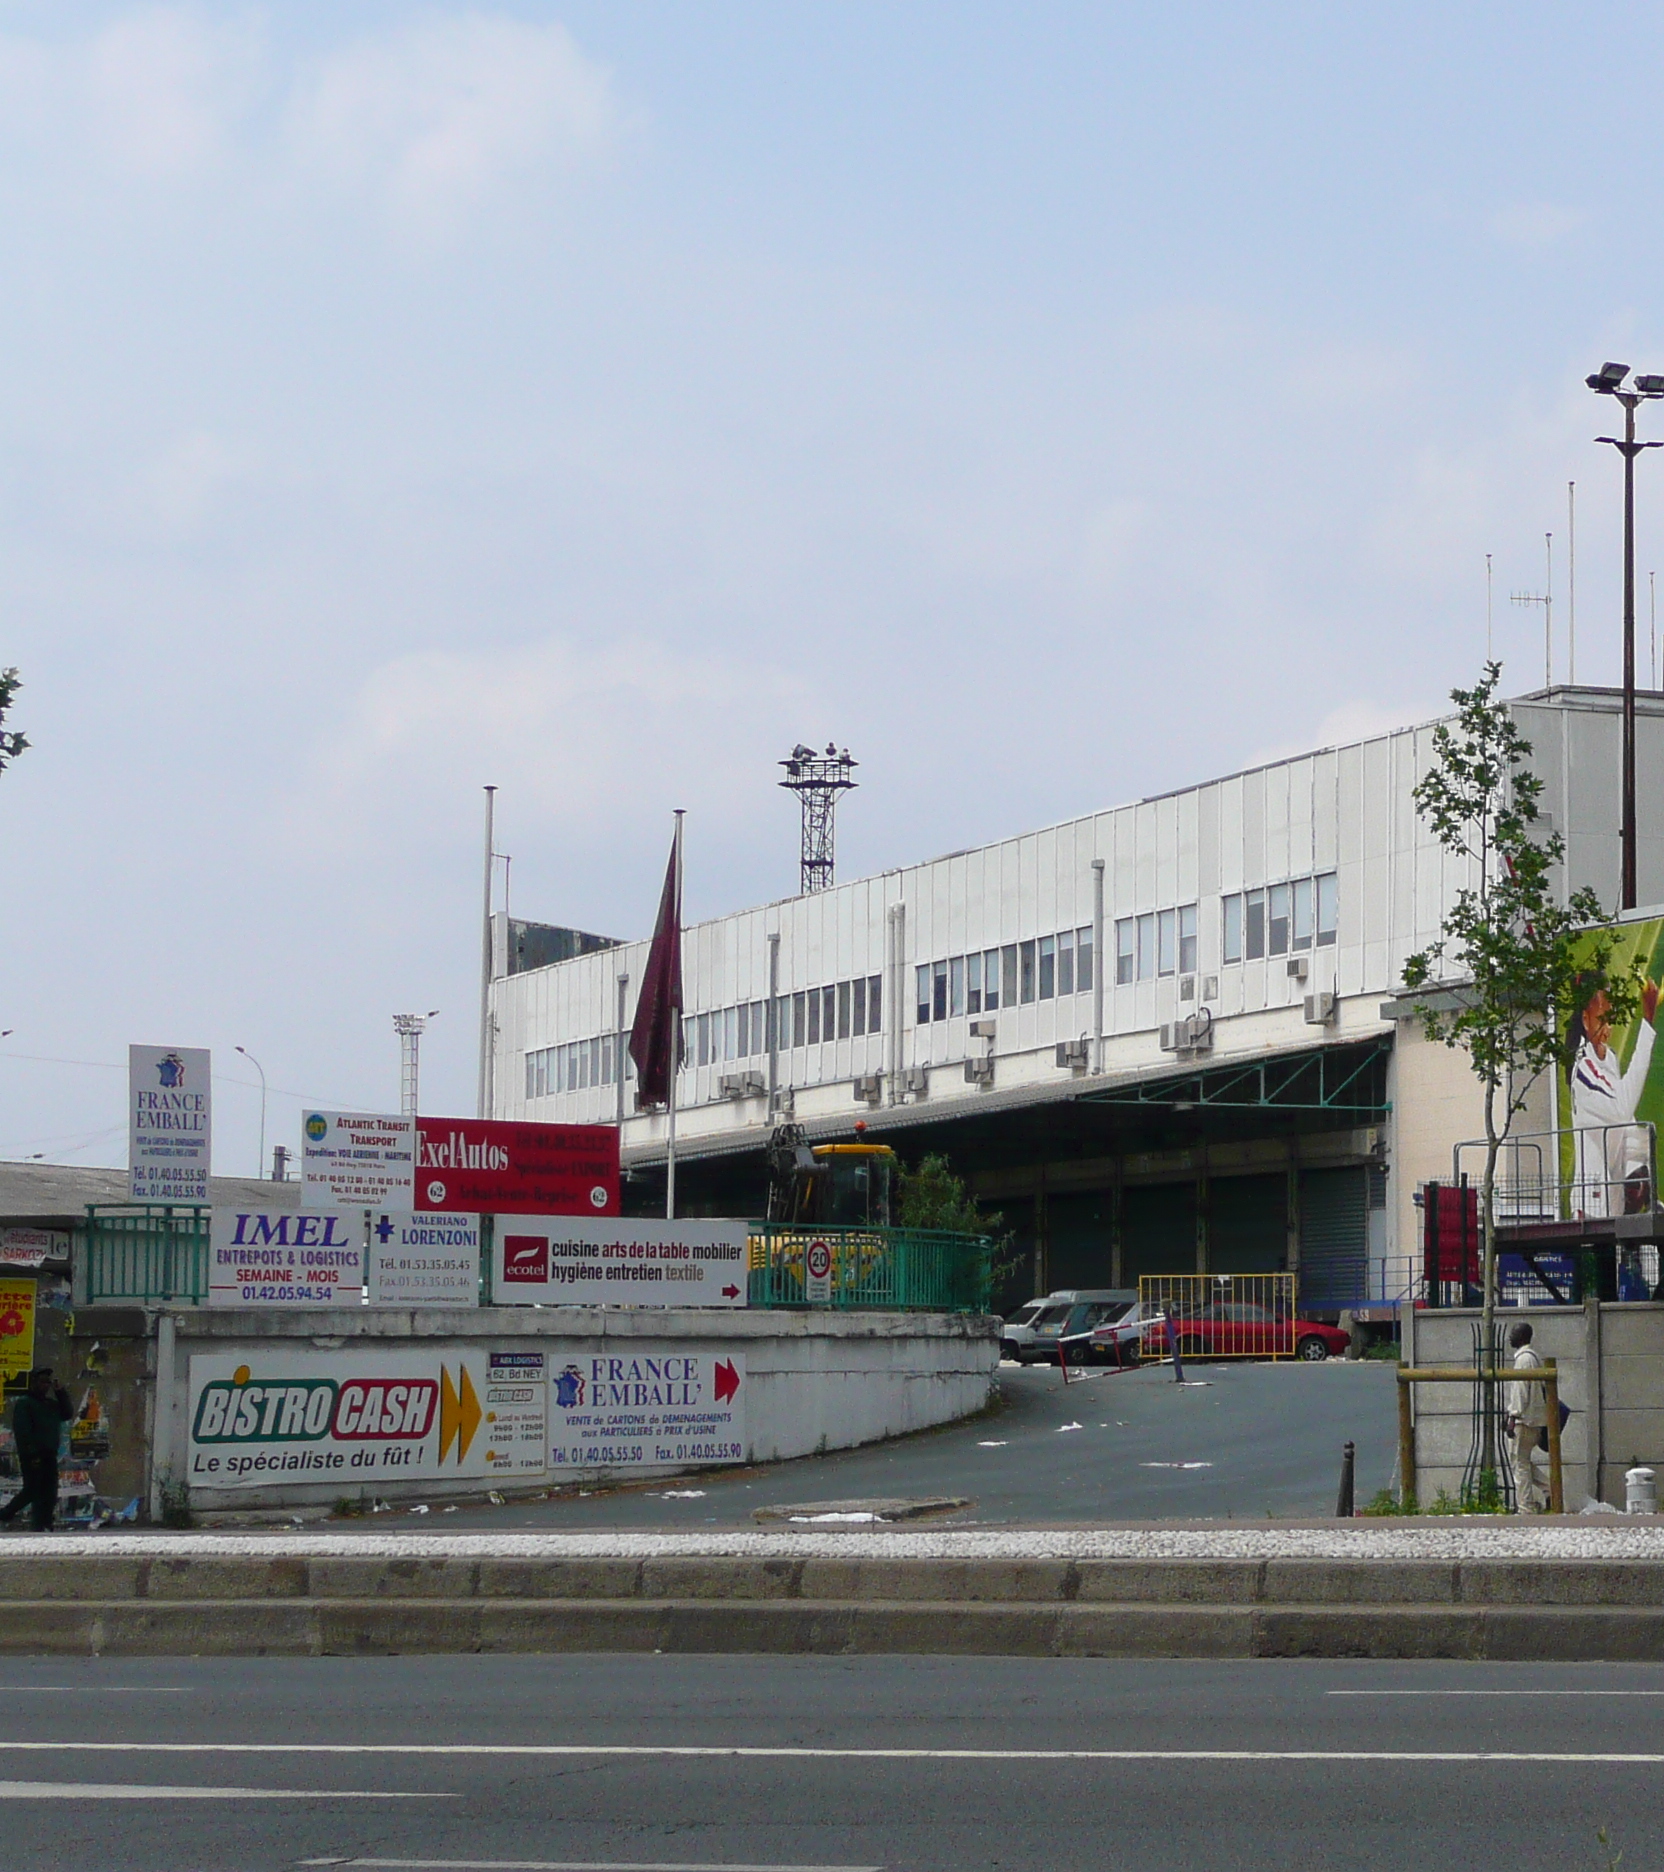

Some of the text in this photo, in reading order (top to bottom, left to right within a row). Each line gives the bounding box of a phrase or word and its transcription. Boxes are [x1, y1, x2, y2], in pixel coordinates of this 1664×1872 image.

[138, 1092, 204, 1112] FRANCE
[136, 1111, 206, 1130] EMBALL'
[350, 1134, 397, 1146] TRANSPORT
[416, 1130, 508, 1170] ExelAutos
[430, 1186, 444, 1198] 62
[592, 1190, 605, 1203] 62
[412, 1216, 468, 1226] VALERIANO
[230, 1214, 350, 1246] IMEL
[402, 1230, 476, 1246] LORENZONI
[288, 1251, 295, 1266] &
[300, 1251, 358, 1266] LOGISTICS
[552, 1240, 742, 1260] cuisine arts de la table mobilier
[812, 1252, 826, 1268] 20
[236, 1269, 292, 1282] SEMAINE
[306, 1270, 338, 1282] MOIS
[507, 1265, 545, 1276] ecotel
[552, 1262, 704, 1284] hygiène entretien textile
[242, 1286, 332, 1300] 01.42.05.94.54
[494, 1369, 541, 1379] 62 Bd NEY
[591, 1358, 698, 1382] FRANCE
[592, 1382, 702, 1406] EMBALL'
[198, 1386, 432, 1436] BISTRO CASH
[566, 1412, 732, 1426] VENTE de CARTONS de DEMENAGEMENTS
[600, 1425, 653, 1436] PARTICULIERS
[664, 1426, 683, 1436] PRIX
[571, 1446, 643, 1462] 01.40.05.55.50
[656, 1446, 674, 1460] Fax.
[676, 1443, 742, 1460] 01.40.05.55.90
[194, 1454, 220, 1472] Le
[226, 1450, 344, 1476] spécialiste
[351, 1449, 376, 1467] du
[382, 1447, 410, 1465] fût
